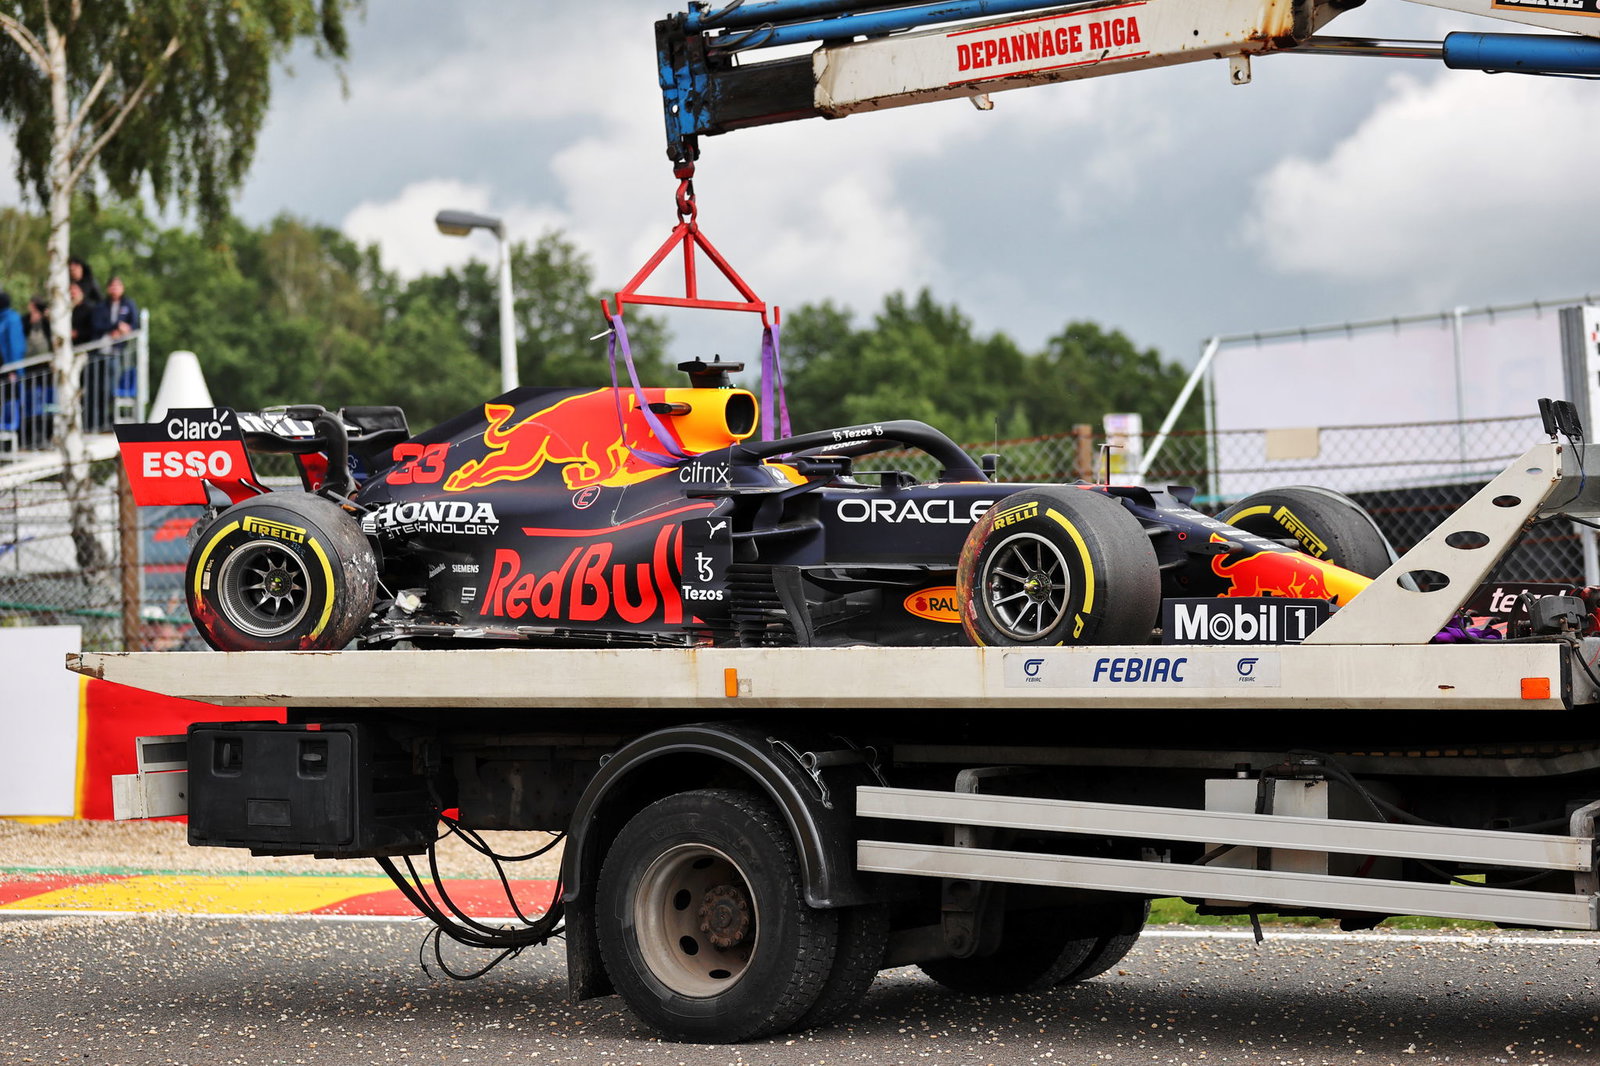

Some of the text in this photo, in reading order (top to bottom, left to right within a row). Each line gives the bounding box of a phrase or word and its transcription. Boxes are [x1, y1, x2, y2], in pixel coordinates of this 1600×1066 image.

[956, 16, 1141, 71] DEPANNAGE RIGA
[168, 415, 223, 440] Claro
[843, 427, 872, 440] Tezos
[142, 450, 232, 477] ESSO
[386, 442, 450, 485] 33
[679, 461, 730, 483] citrix
[362, 501, 499, 527] HONDA
[837, 499, 995, 524] ORACLE
[242, 515, 307, 544] PIRELLI
[1273, 505, 1329, 559] PIRELLI
[451, 564, 480, 573] SIEMENS
[569, 523, 683, 624] Bul
[682, 585, 724, 600] Tezos
[929, 597, 960, 612] RAU
[1174, 603, 1306, 641] Mobil 1
[1092, 657, 1188, 683] FEBIAC
